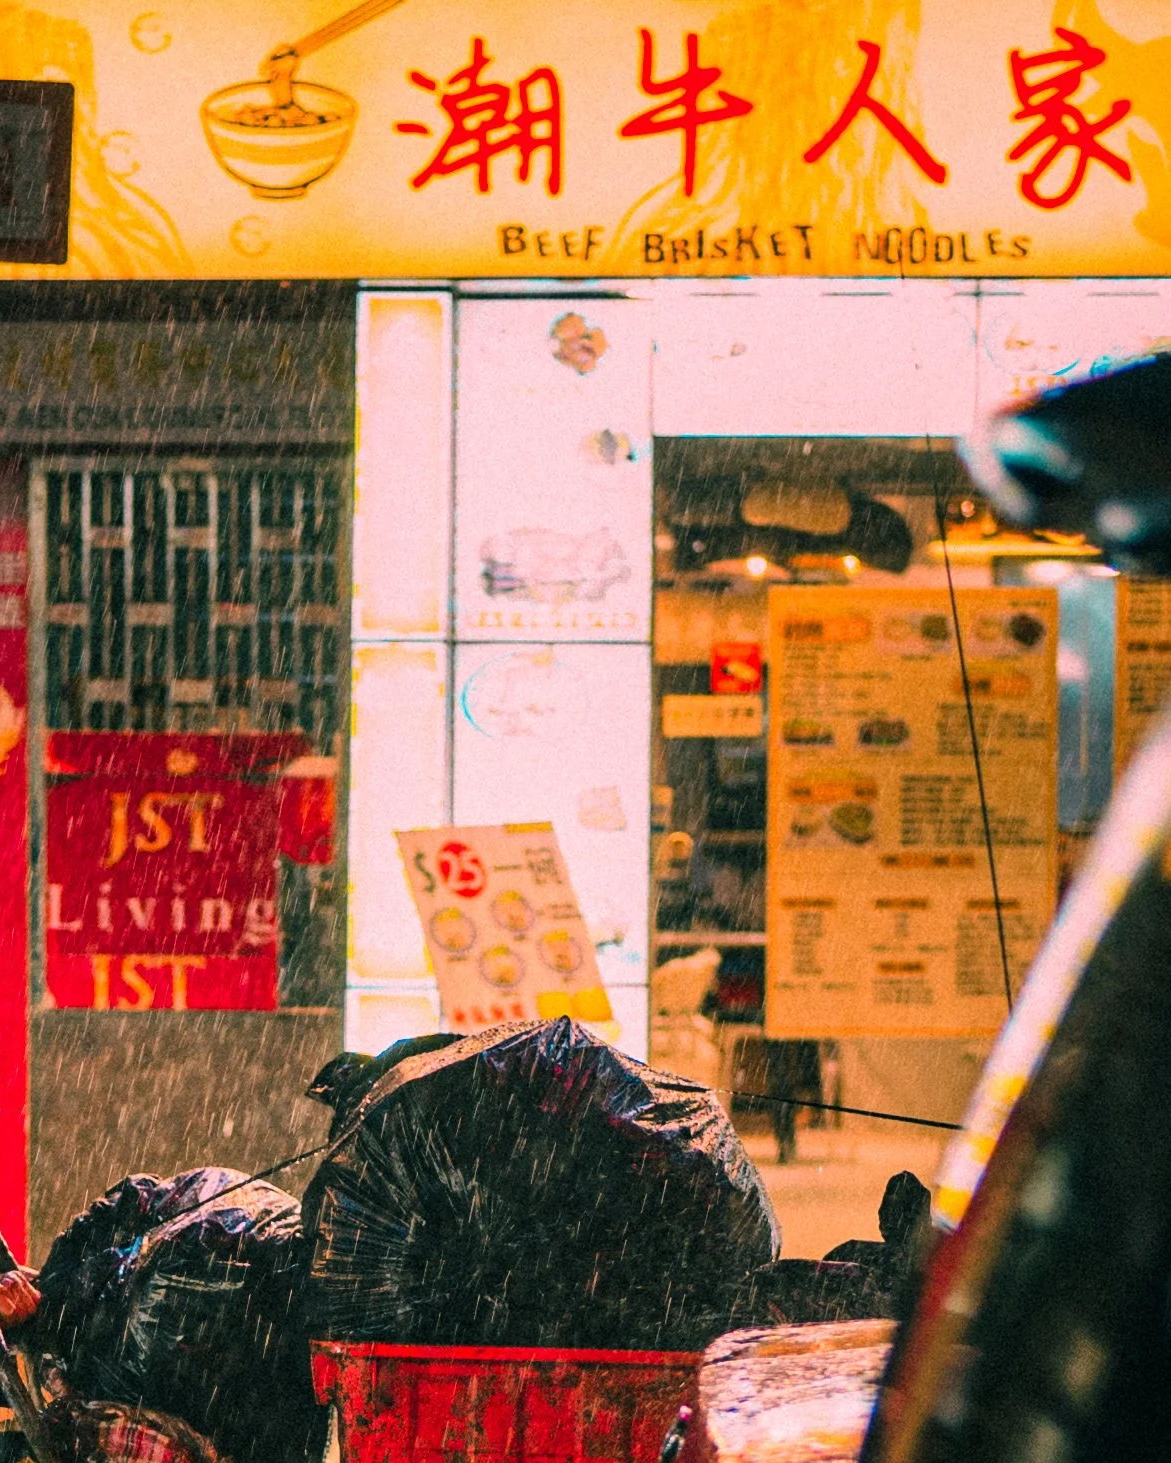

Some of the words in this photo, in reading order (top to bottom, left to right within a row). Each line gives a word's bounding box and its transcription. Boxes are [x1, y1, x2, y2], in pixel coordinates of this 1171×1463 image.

[392, 26, 1134, 211] 潮牛人家
[501, 225, 606, 262] BEEF
[643, 224, 814, 265] BRISKET
[854, 226, 1031, 265] NOODLES
[101, 790, 224, 867] JST
[47, 882, 277, 952] Living
